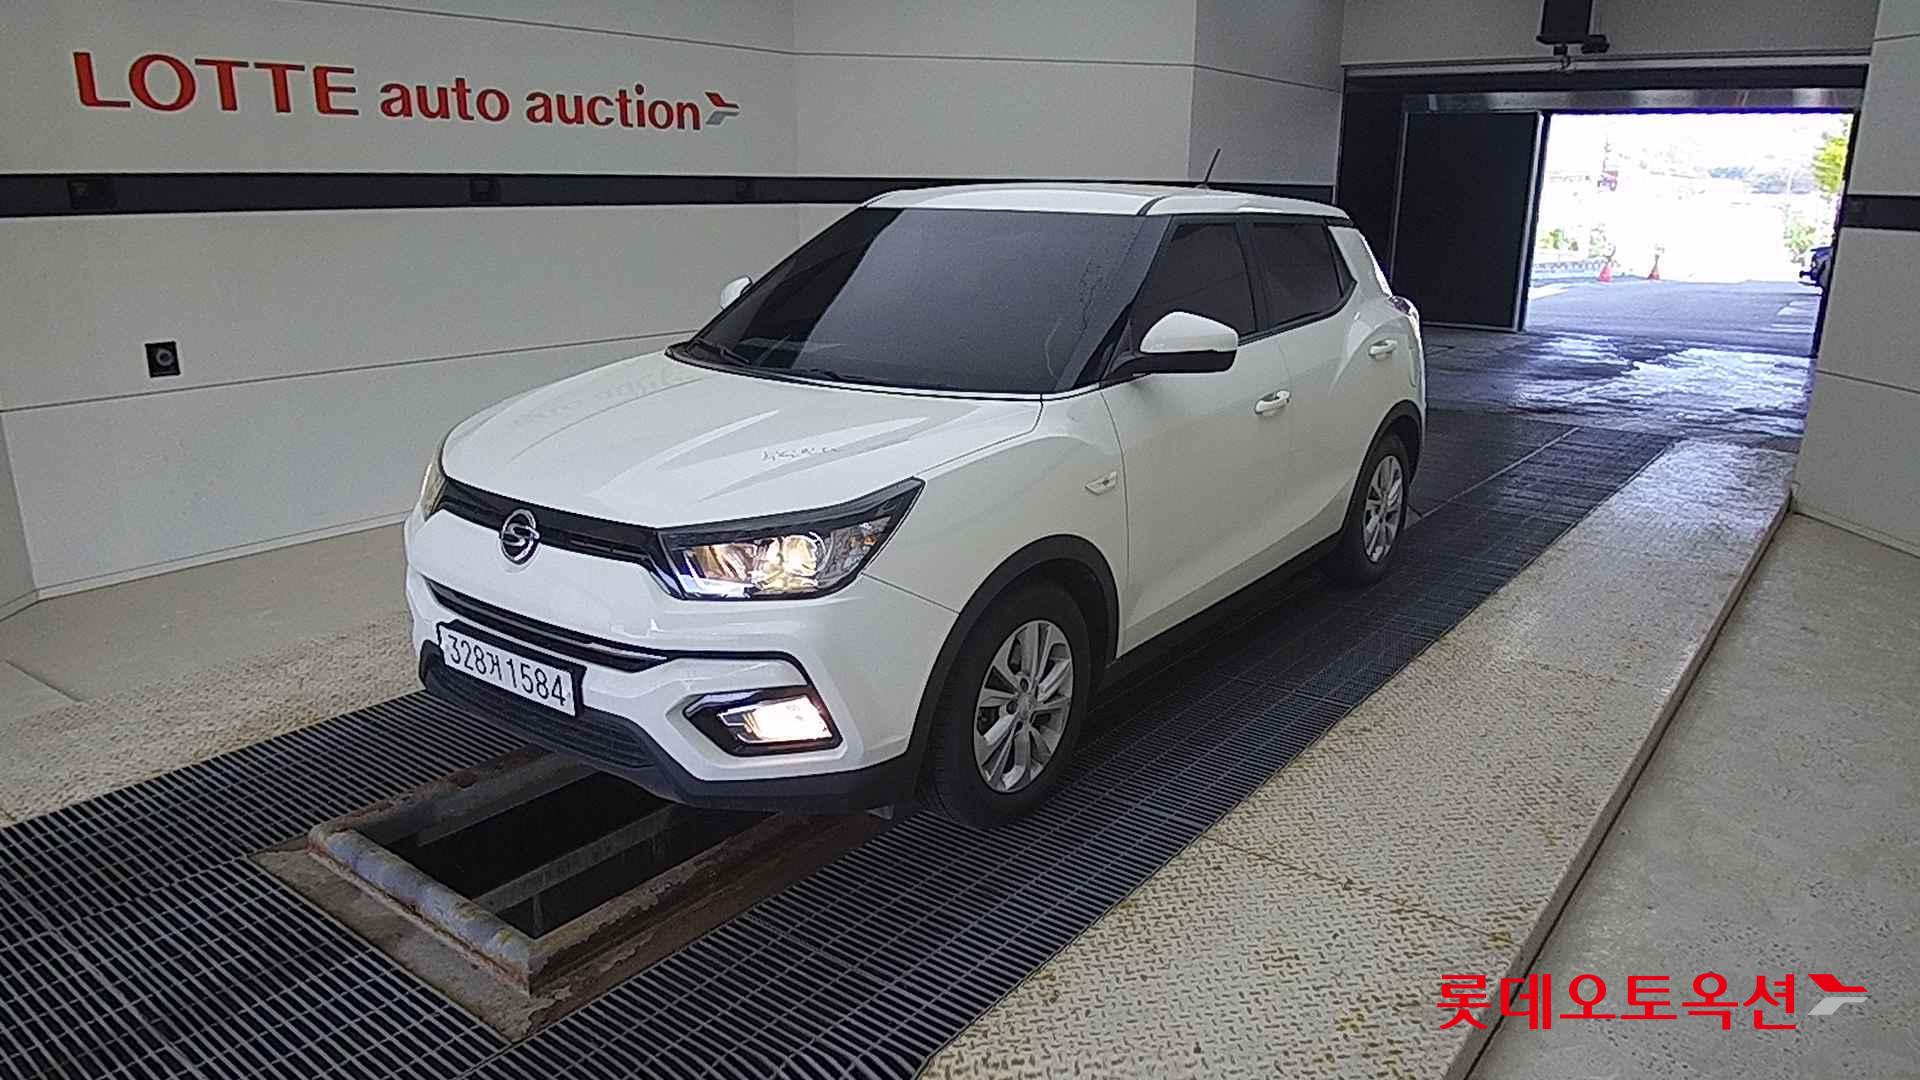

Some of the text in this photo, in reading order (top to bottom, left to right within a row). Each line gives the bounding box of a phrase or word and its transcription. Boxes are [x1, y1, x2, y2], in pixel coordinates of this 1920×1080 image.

[73, 51, 701, 131] LOTTE auto auction
